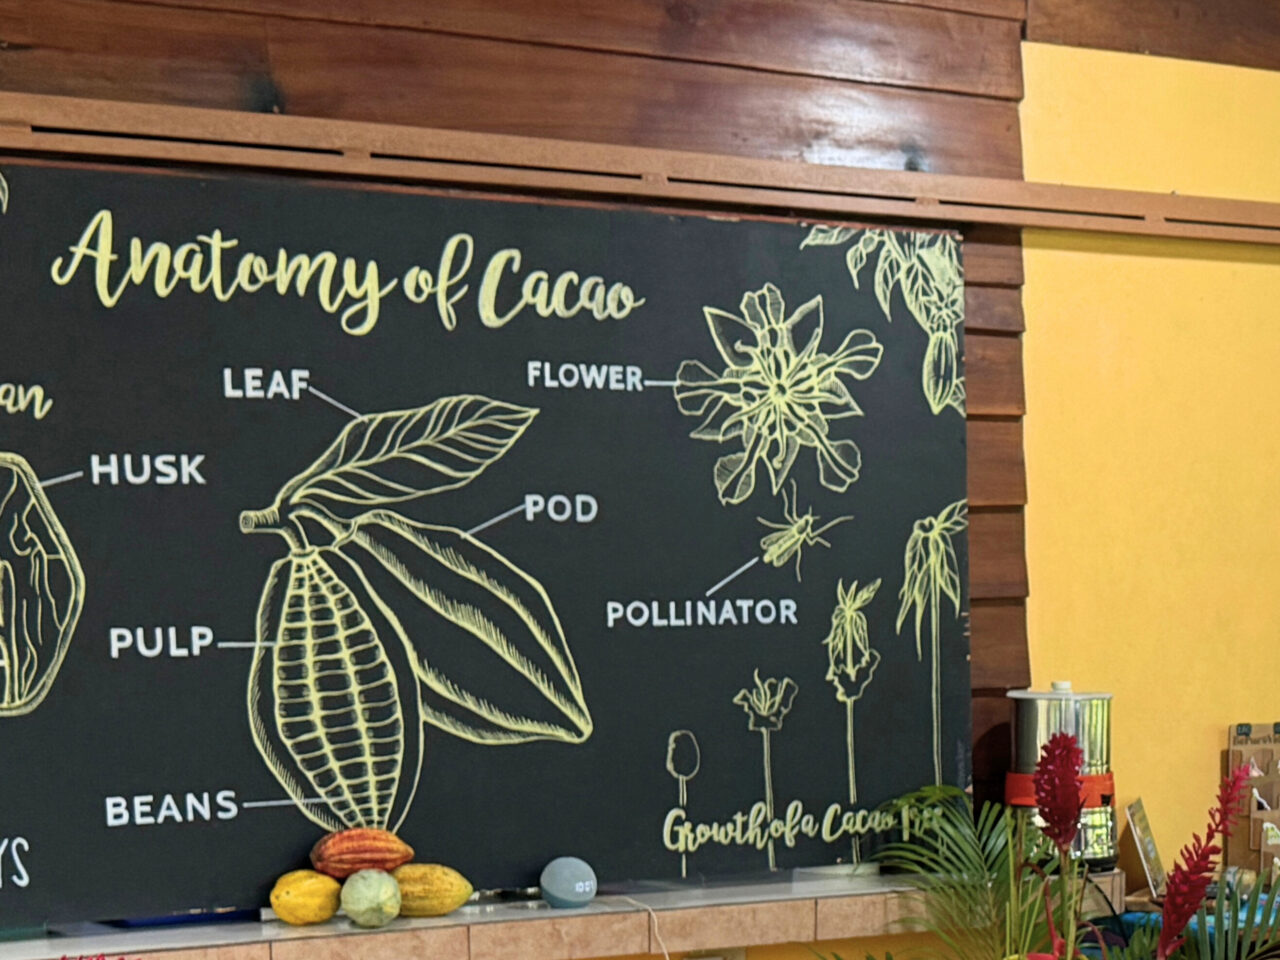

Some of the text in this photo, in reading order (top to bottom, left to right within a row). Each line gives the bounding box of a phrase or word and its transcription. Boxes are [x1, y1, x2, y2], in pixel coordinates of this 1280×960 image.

[50, 209, 646, 336] Anatomy of Cacao
[222, 367, 311, 401] LEAF
[526, 360, 644, 392] FLOWER
[90, 453, 207, 486] HUSK
[524, 494, 599, 524] POD
[606, 598, 799, 629] POLLINATOR
[109, 625, 215, 660] PULP
[105, 790, 239, 827] BEANS
[663, 801, 770, 852] Growth
[769, 800, 803, 848] of
[801, 813, 819, 838] a
[821, 803, 898, 843] Cacao
